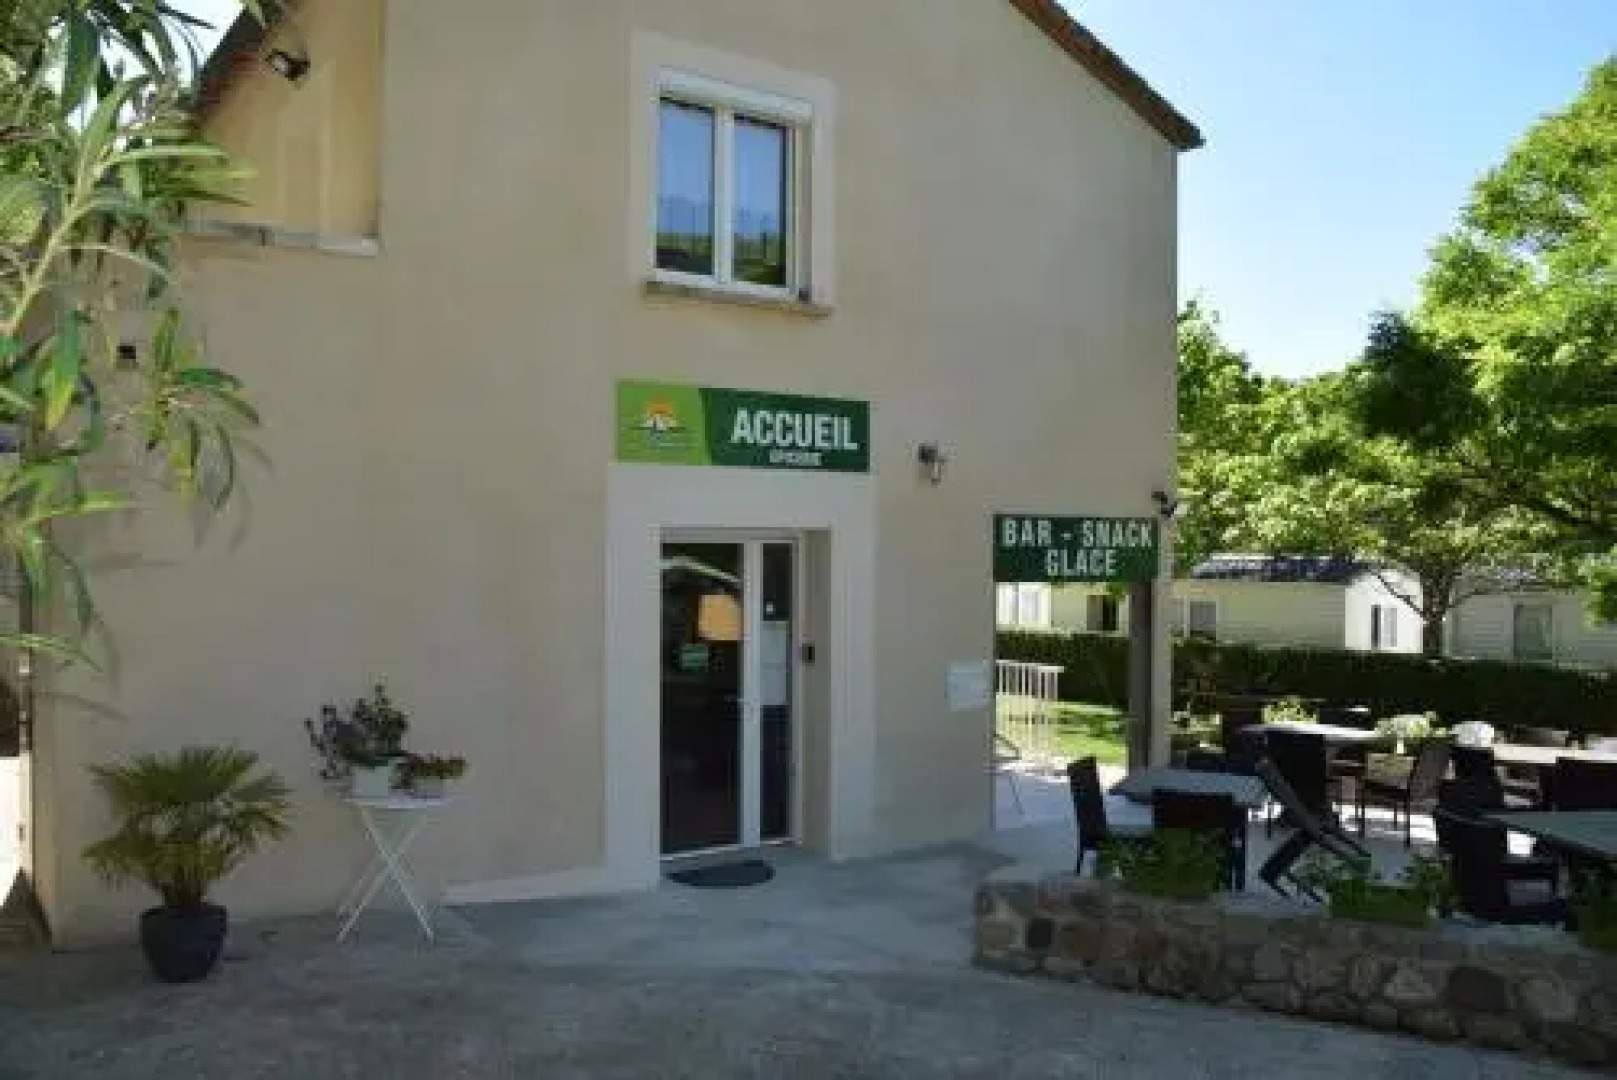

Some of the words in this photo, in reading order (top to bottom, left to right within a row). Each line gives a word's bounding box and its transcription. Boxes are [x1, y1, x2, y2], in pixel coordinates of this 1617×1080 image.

[730, 407, 858, 450] ACCUEIL
[1003, 518, 1051, 547] BAR
[1082, 520, 1153, 547] SNACK
[1046, 549, 1117, 576] GLACE
